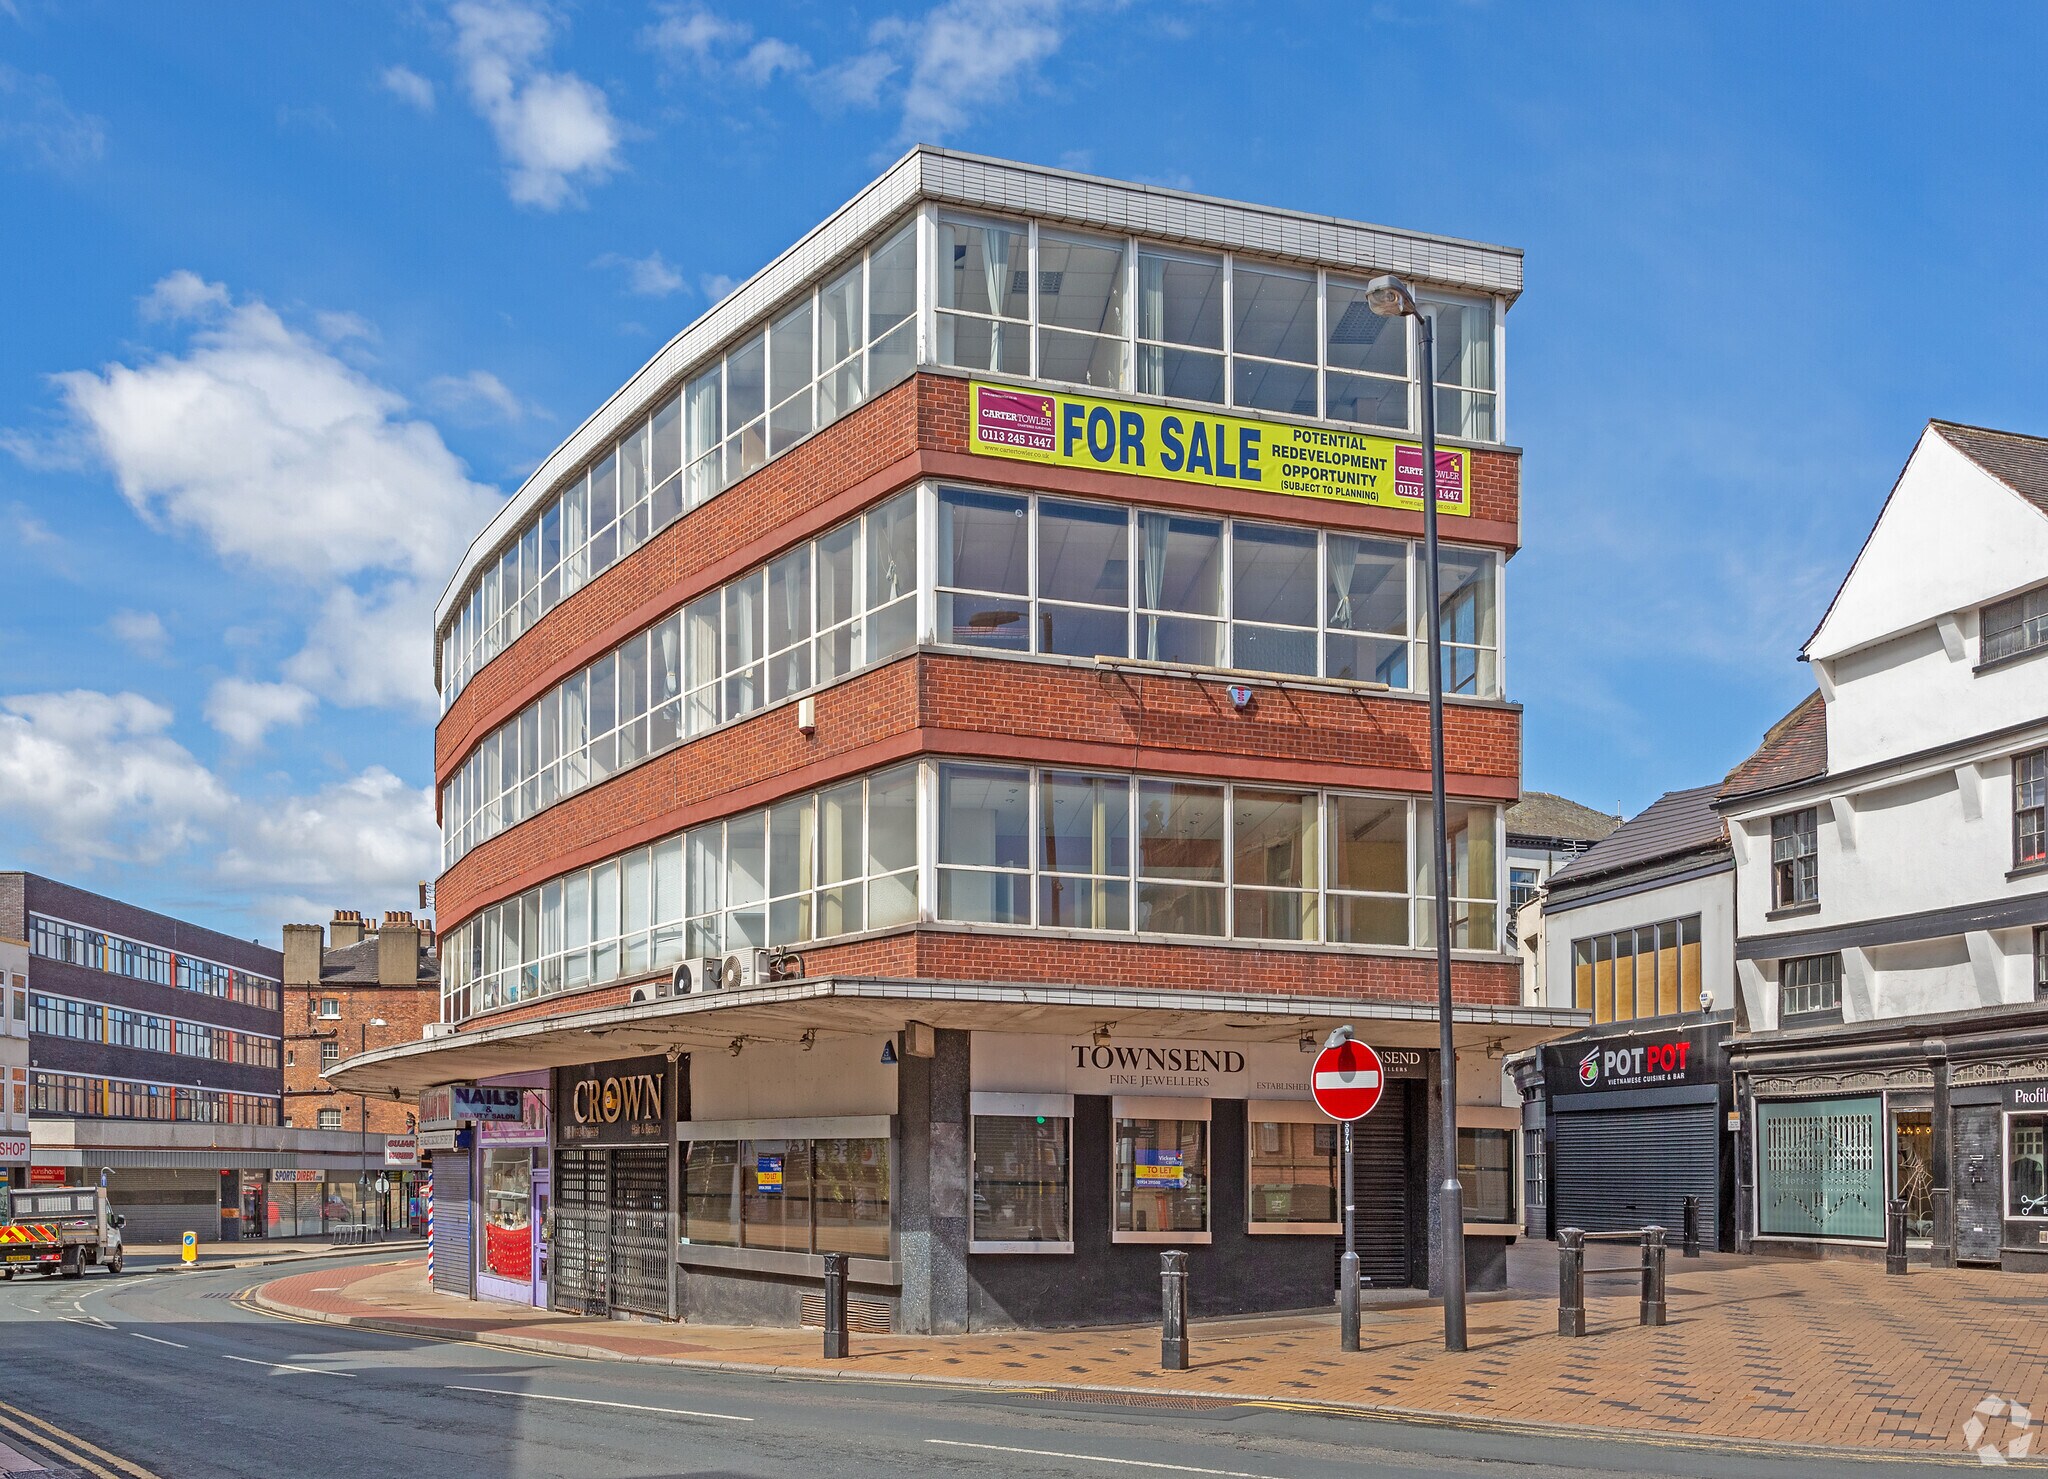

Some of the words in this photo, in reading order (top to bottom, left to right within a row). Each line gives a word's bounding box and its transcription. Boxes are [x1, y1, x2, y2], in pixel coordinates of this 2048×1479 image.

[981, 408, 1052, 426] CARTERTOWLER
[981, 428, 1005, 442] 0113
[1007, 432, 1025, 445] 245
[1028, 435, 1051, 448] 1447
[1063, 402, 1146, 468] FOR
[1160, 415, 1262, 482] SALE
[1293, 429, 1367, 450] POTENTIAL
[1271, 444, 1387, 471] REDEVELOPMENT
[1282, 463, 1377, 488] OPPORTUNITY
[1280, 480, 1320, 493] (SUBJECT
[1322, 485, 1333, 495] TO
[1335, 487, 1379, 502] PLANNING)
[1398, 484, 1419, 496] 0113
[1439, 489, 1460, 501] 1447
[1071, 1045, 1245, 1073] TOWNSEND
[1604, 1047, 1644, 1077] POT
[1647, 1041, 1690, 1073] POT
[1109, 1074, 1137, 1086] FINE
[1140, 1075, 1210, 1088] JEWELLERS
[1256, 1082, 1310, 1092] ESTABLISHED
[1607, 1076, 1641, 1085] VIETNAMESE
[1643, 1074, 1665, 1083] CUISINE
[1673, 1072, 1685, 1080] BAR
[455, 1088, 519, 1106] NAILS
[573, 1073, 664, 1124] CROWN
[485, 1105, 492, 1113] &
[0, 1142, 26, 1156] SHOP
[1147, 1166, 1158, 1174] TO
[1160, 1166, 1173, 1174] LET
